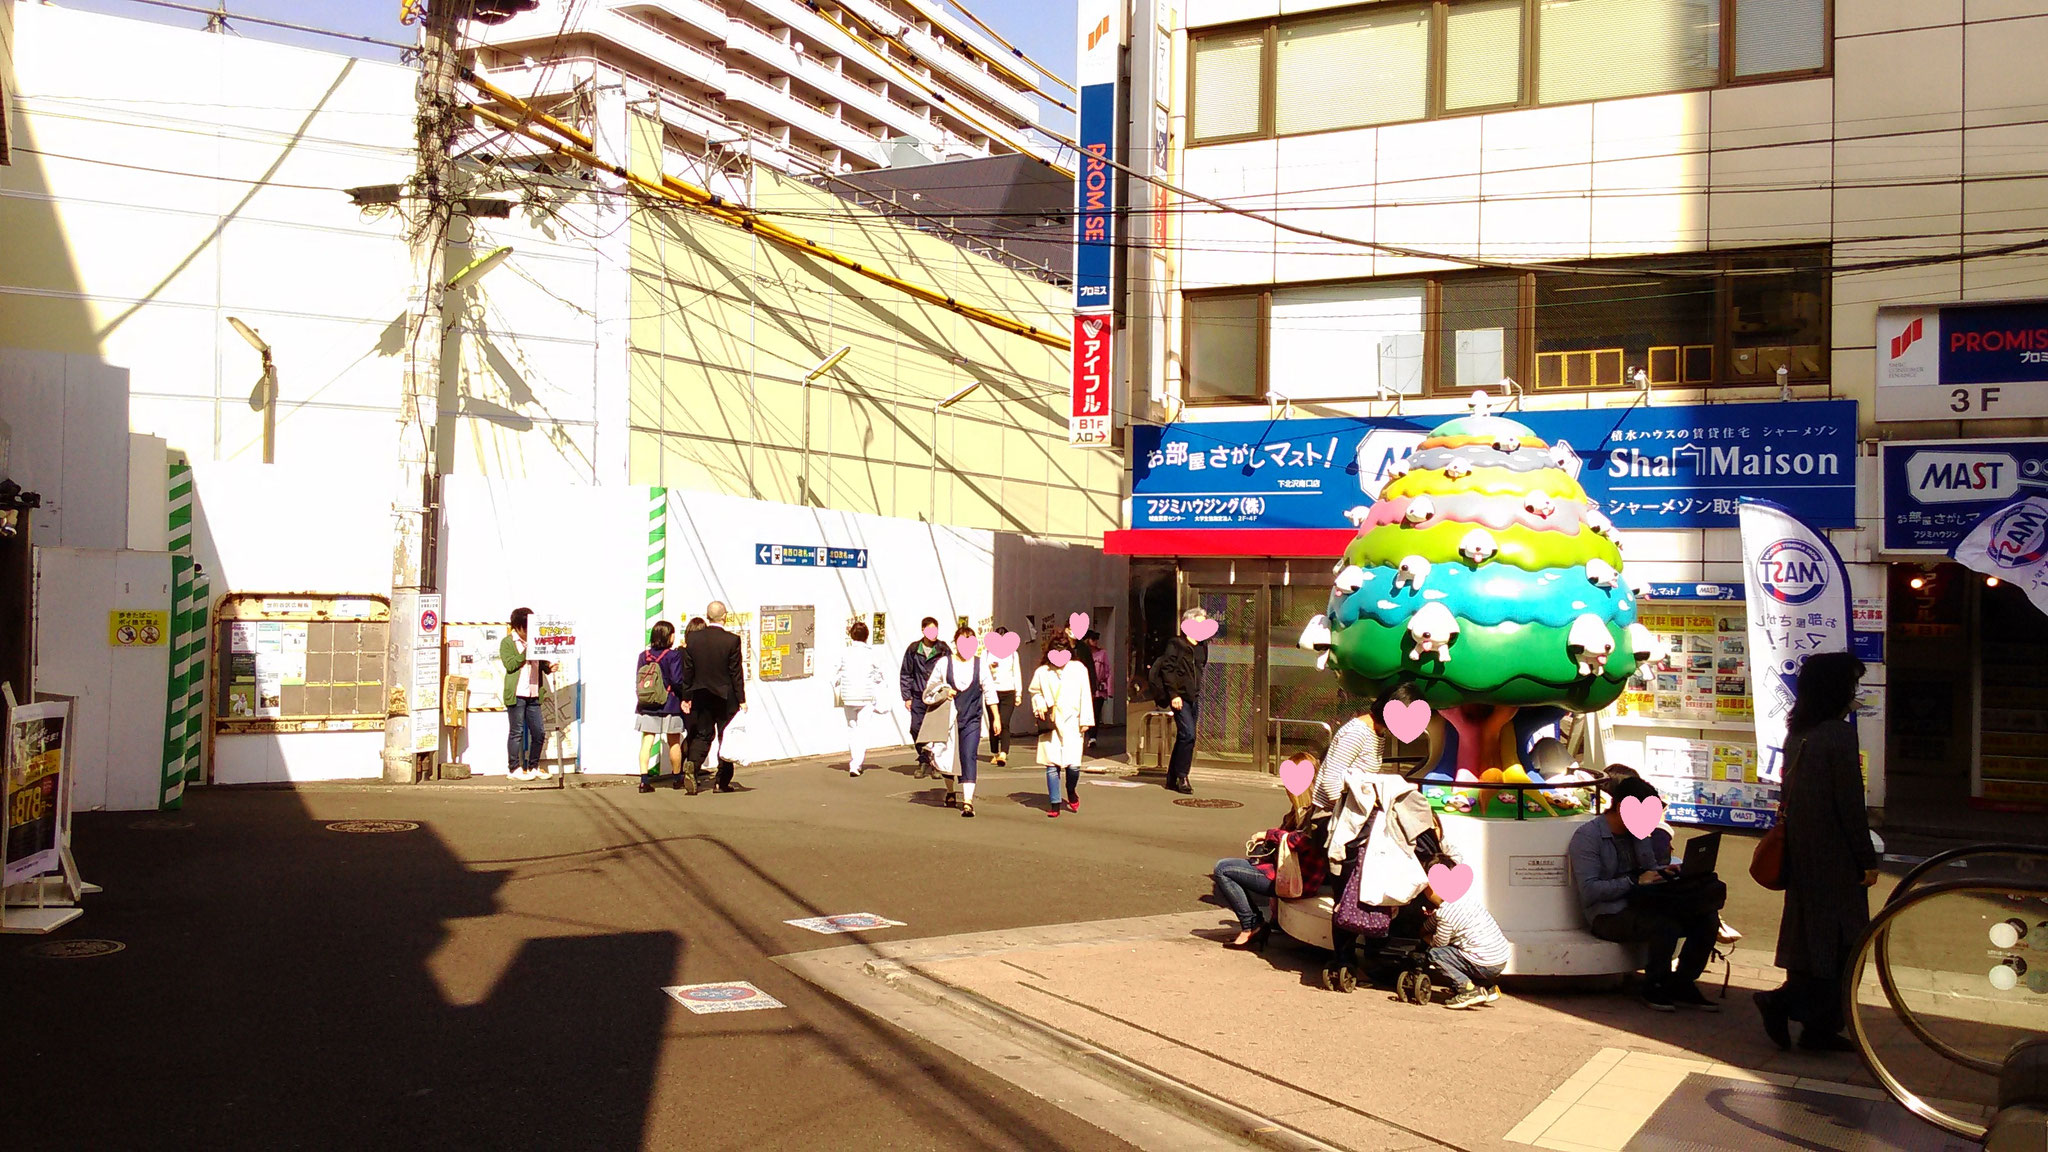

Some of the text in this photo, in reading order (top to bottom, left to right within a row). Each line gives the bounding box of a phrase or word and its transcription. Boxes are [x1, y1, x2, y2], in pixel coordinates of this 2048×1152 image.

[1080, 286, 1108, 297] プロミス
[1951, 328, 2048, 353] PROMIS
[2019, 351, 2048, 364] プロミ
[1083, 340, 1101, 413] アイフル
[1079, 418, 1104, 430] B1F
[1076, 432, 1093, 442] 入口
[1610, 426, 1839, 442] 積水ハウスの賃貸住宅 シャーメゾン
[1710, 445, 1839, 476] Maison
[1919, 462, 2004, 490] MAST
[1147, 497, 1265, 515] フジミハウジング(株)
[1699, 586, 1717, 594] MAST
[1733, 812, 1753, 820] MAST
